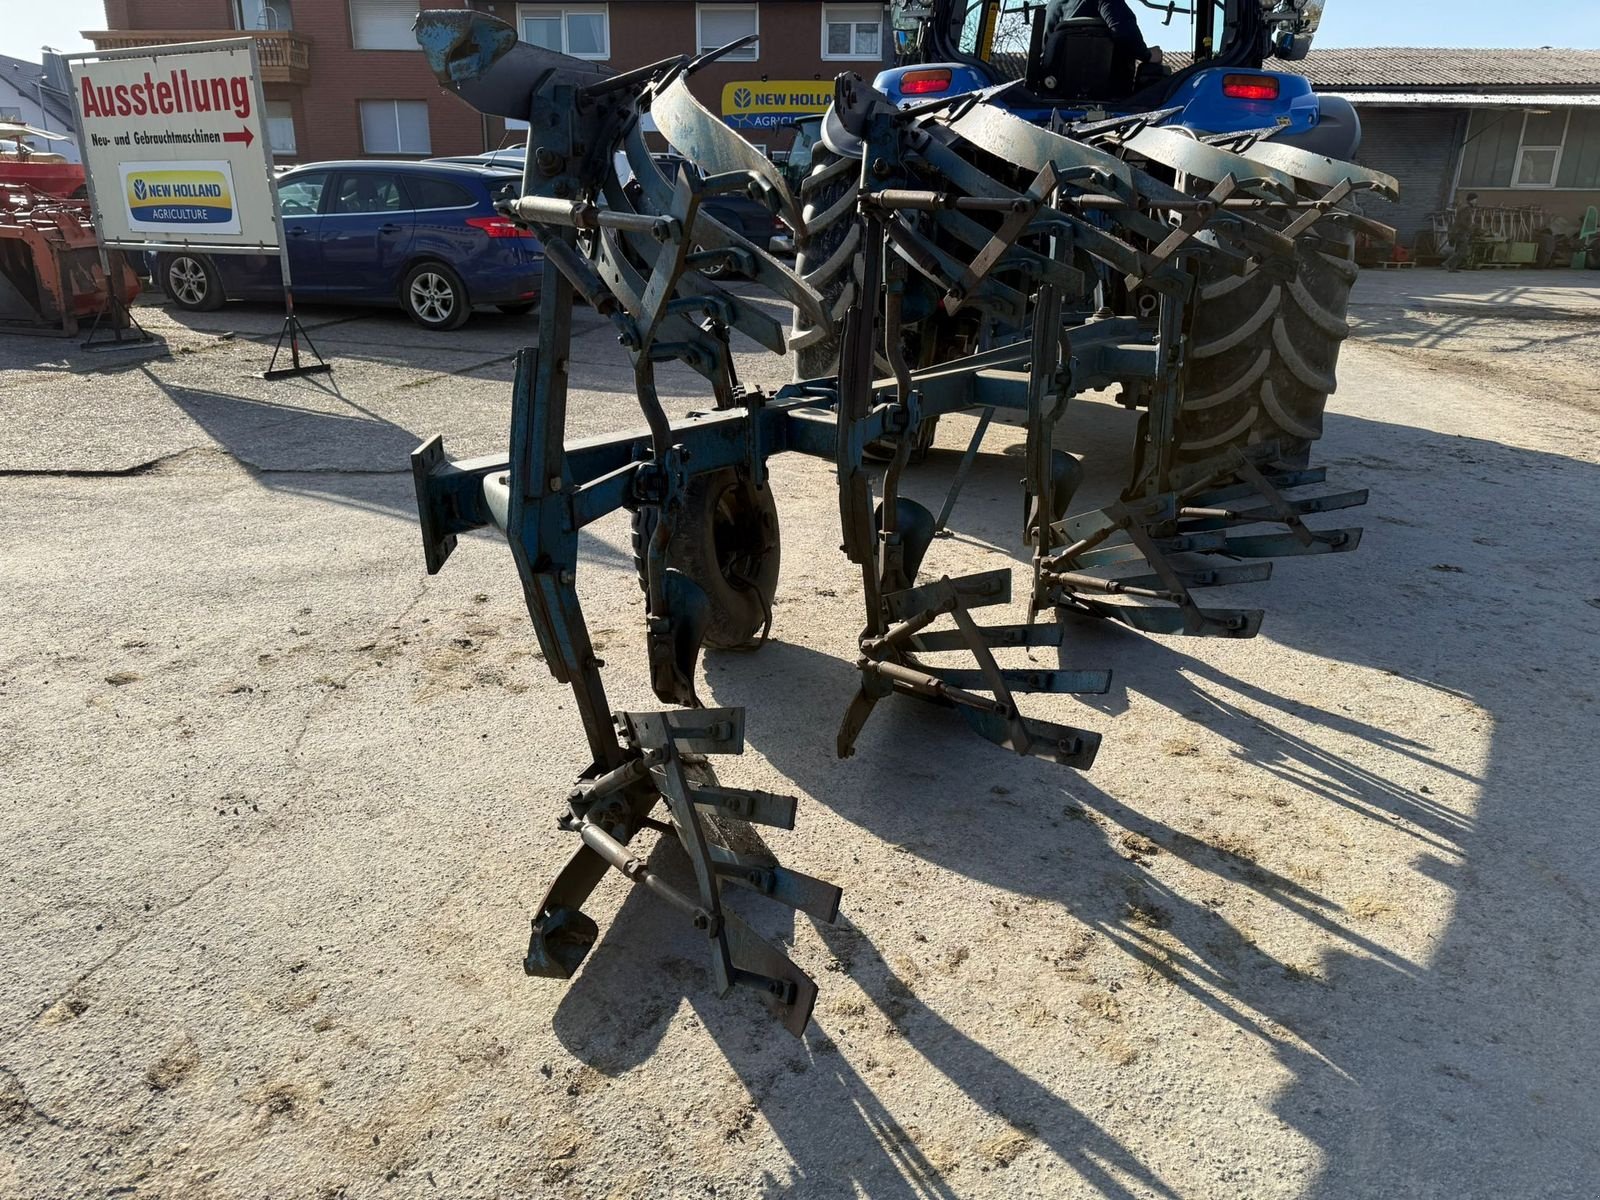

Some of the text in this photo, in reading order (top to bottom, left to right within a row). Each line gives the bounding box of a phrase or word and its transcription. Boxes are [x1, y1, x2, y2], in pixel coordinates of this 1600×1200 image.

[81, 69, 250, 119] Ausstellung
[755, 94, 832, 105] NEW HOLLA
[91, 128, 221, 146] Neu- und Gebrauchtmaschinen
[149, 184, 221, 197] NEW HOLLAND
[152, 208, 208, 220] AGRICULTURE
